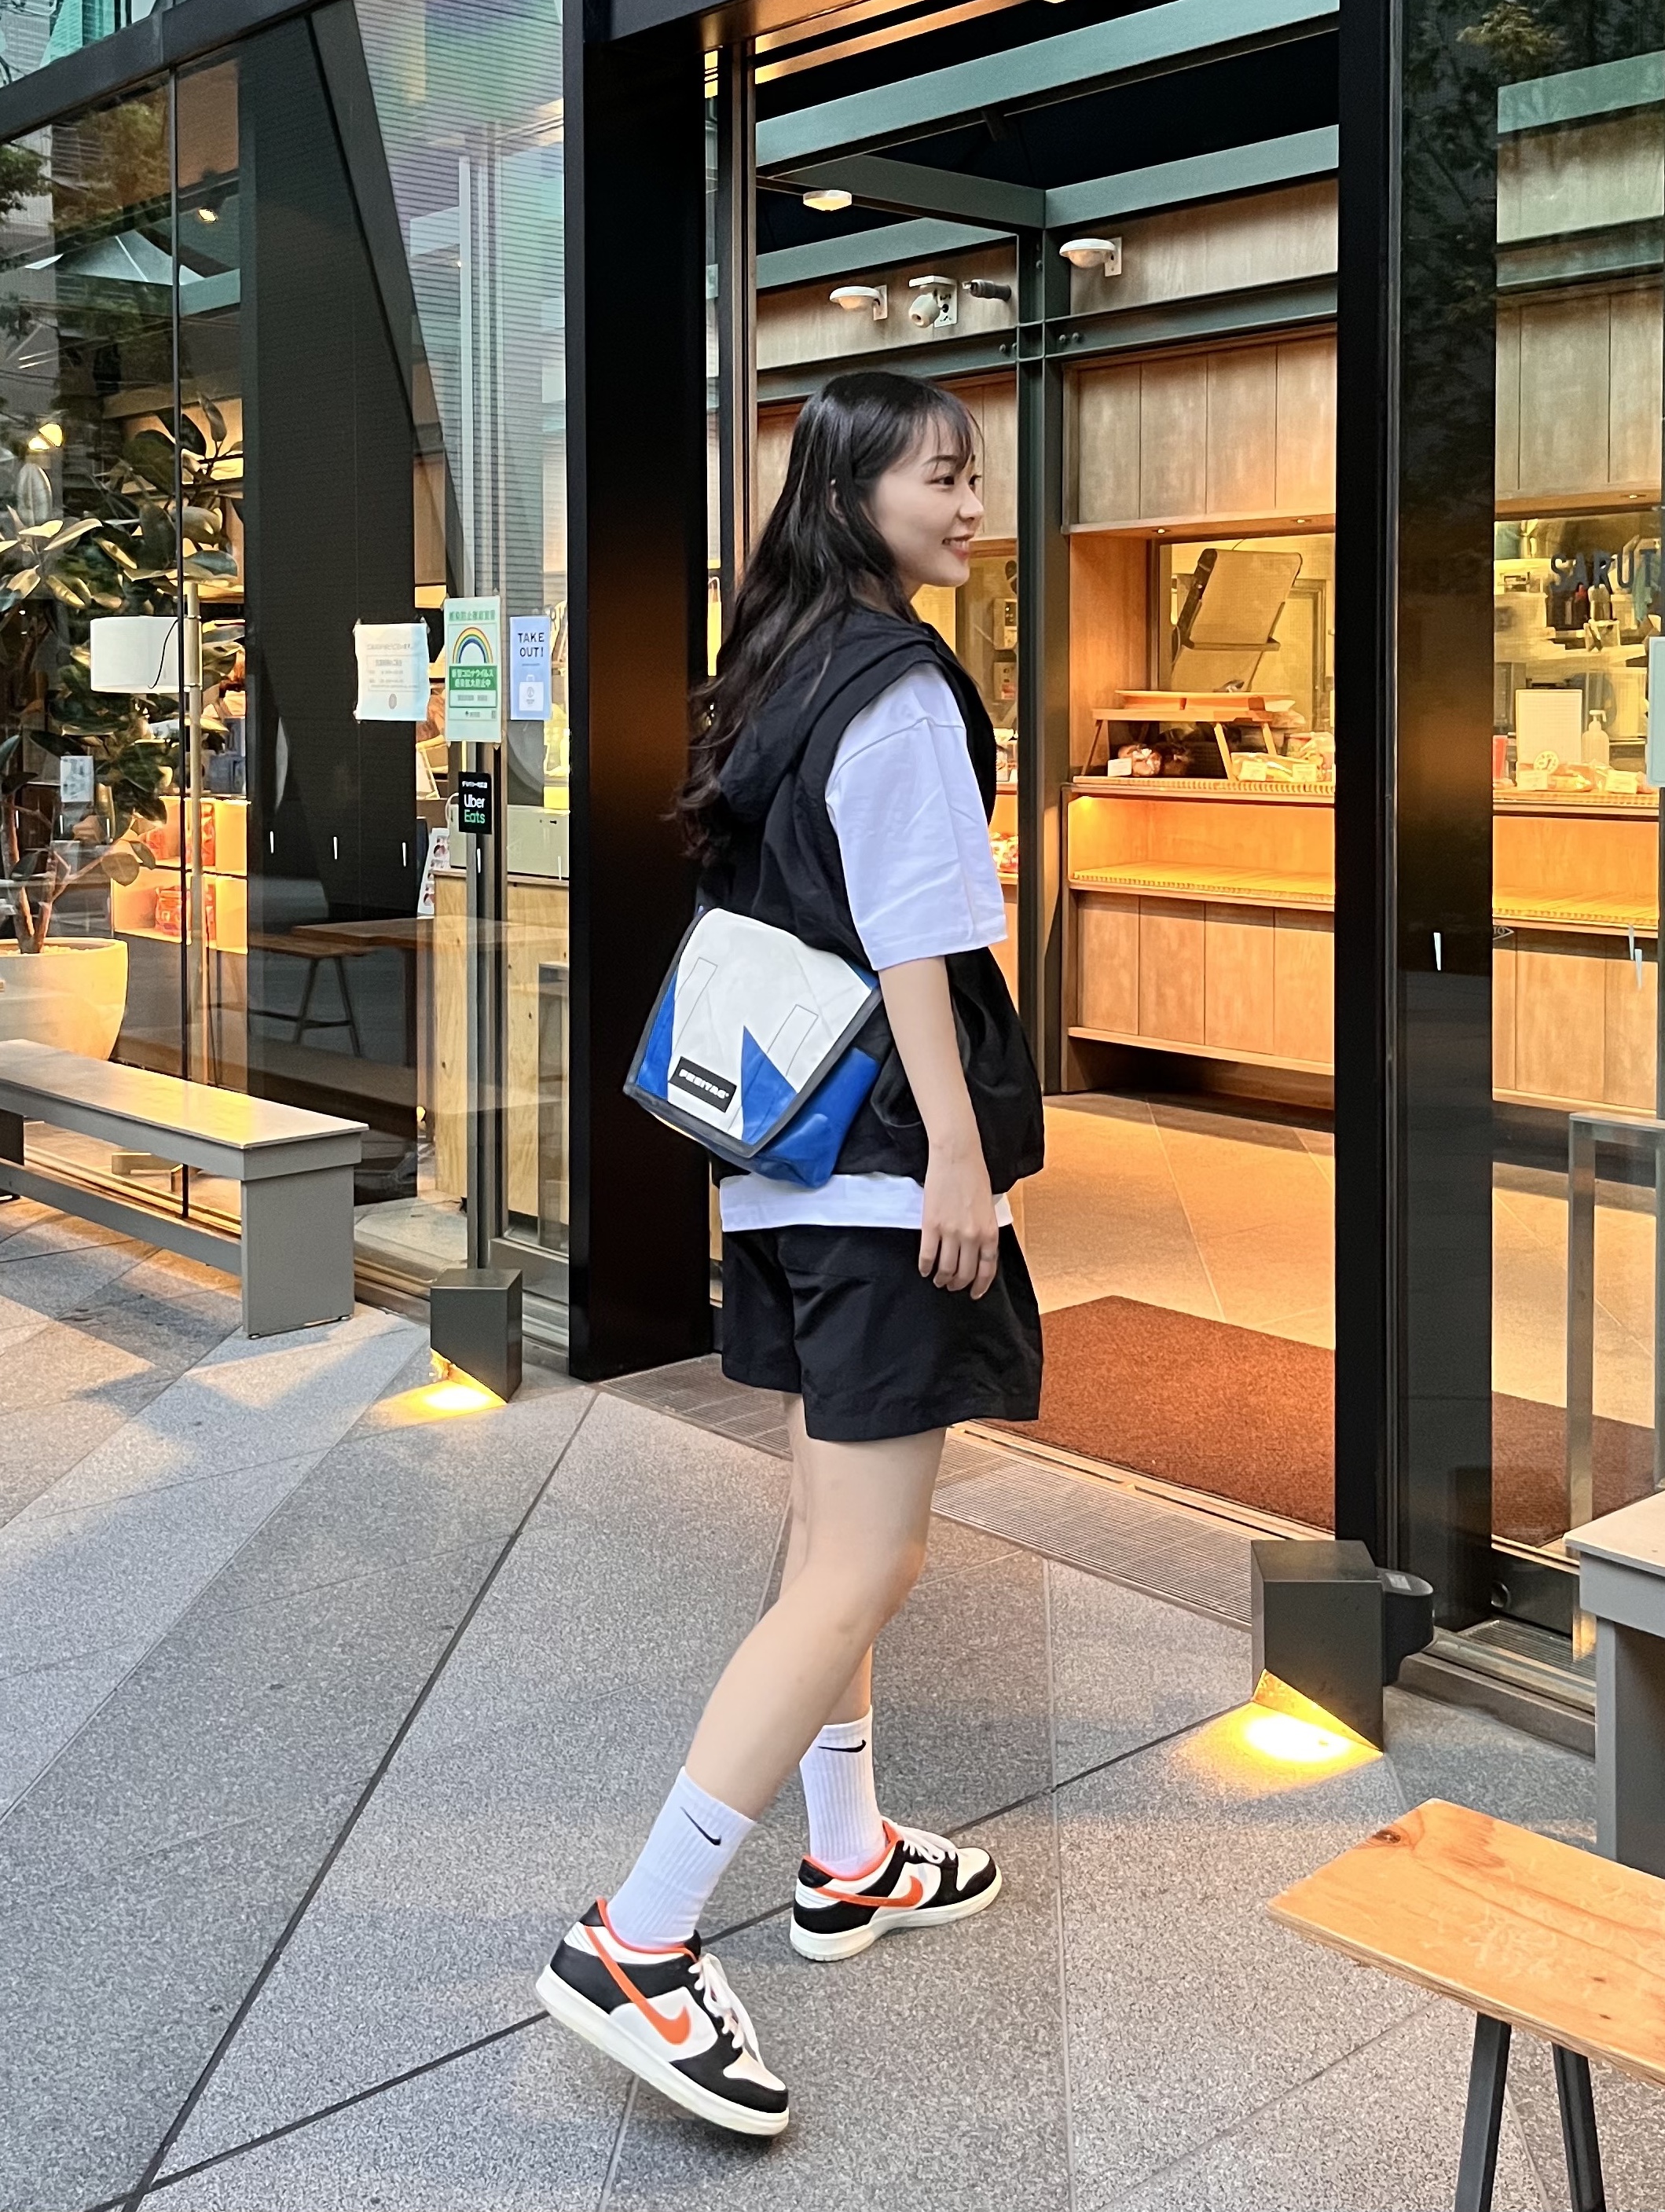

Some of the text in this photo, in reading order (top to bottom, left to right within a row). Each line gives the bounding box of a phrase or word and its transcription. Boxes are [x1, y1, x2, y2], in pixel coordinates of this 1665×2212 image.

[518, 632, 545, 644] TAKE
[519, 647, 544, 658] OUT!
[464, 794, 486, 809] Uber
[464, 809, 486, 824] Eats
[678, 1069, 727, 1099] FREITAG
